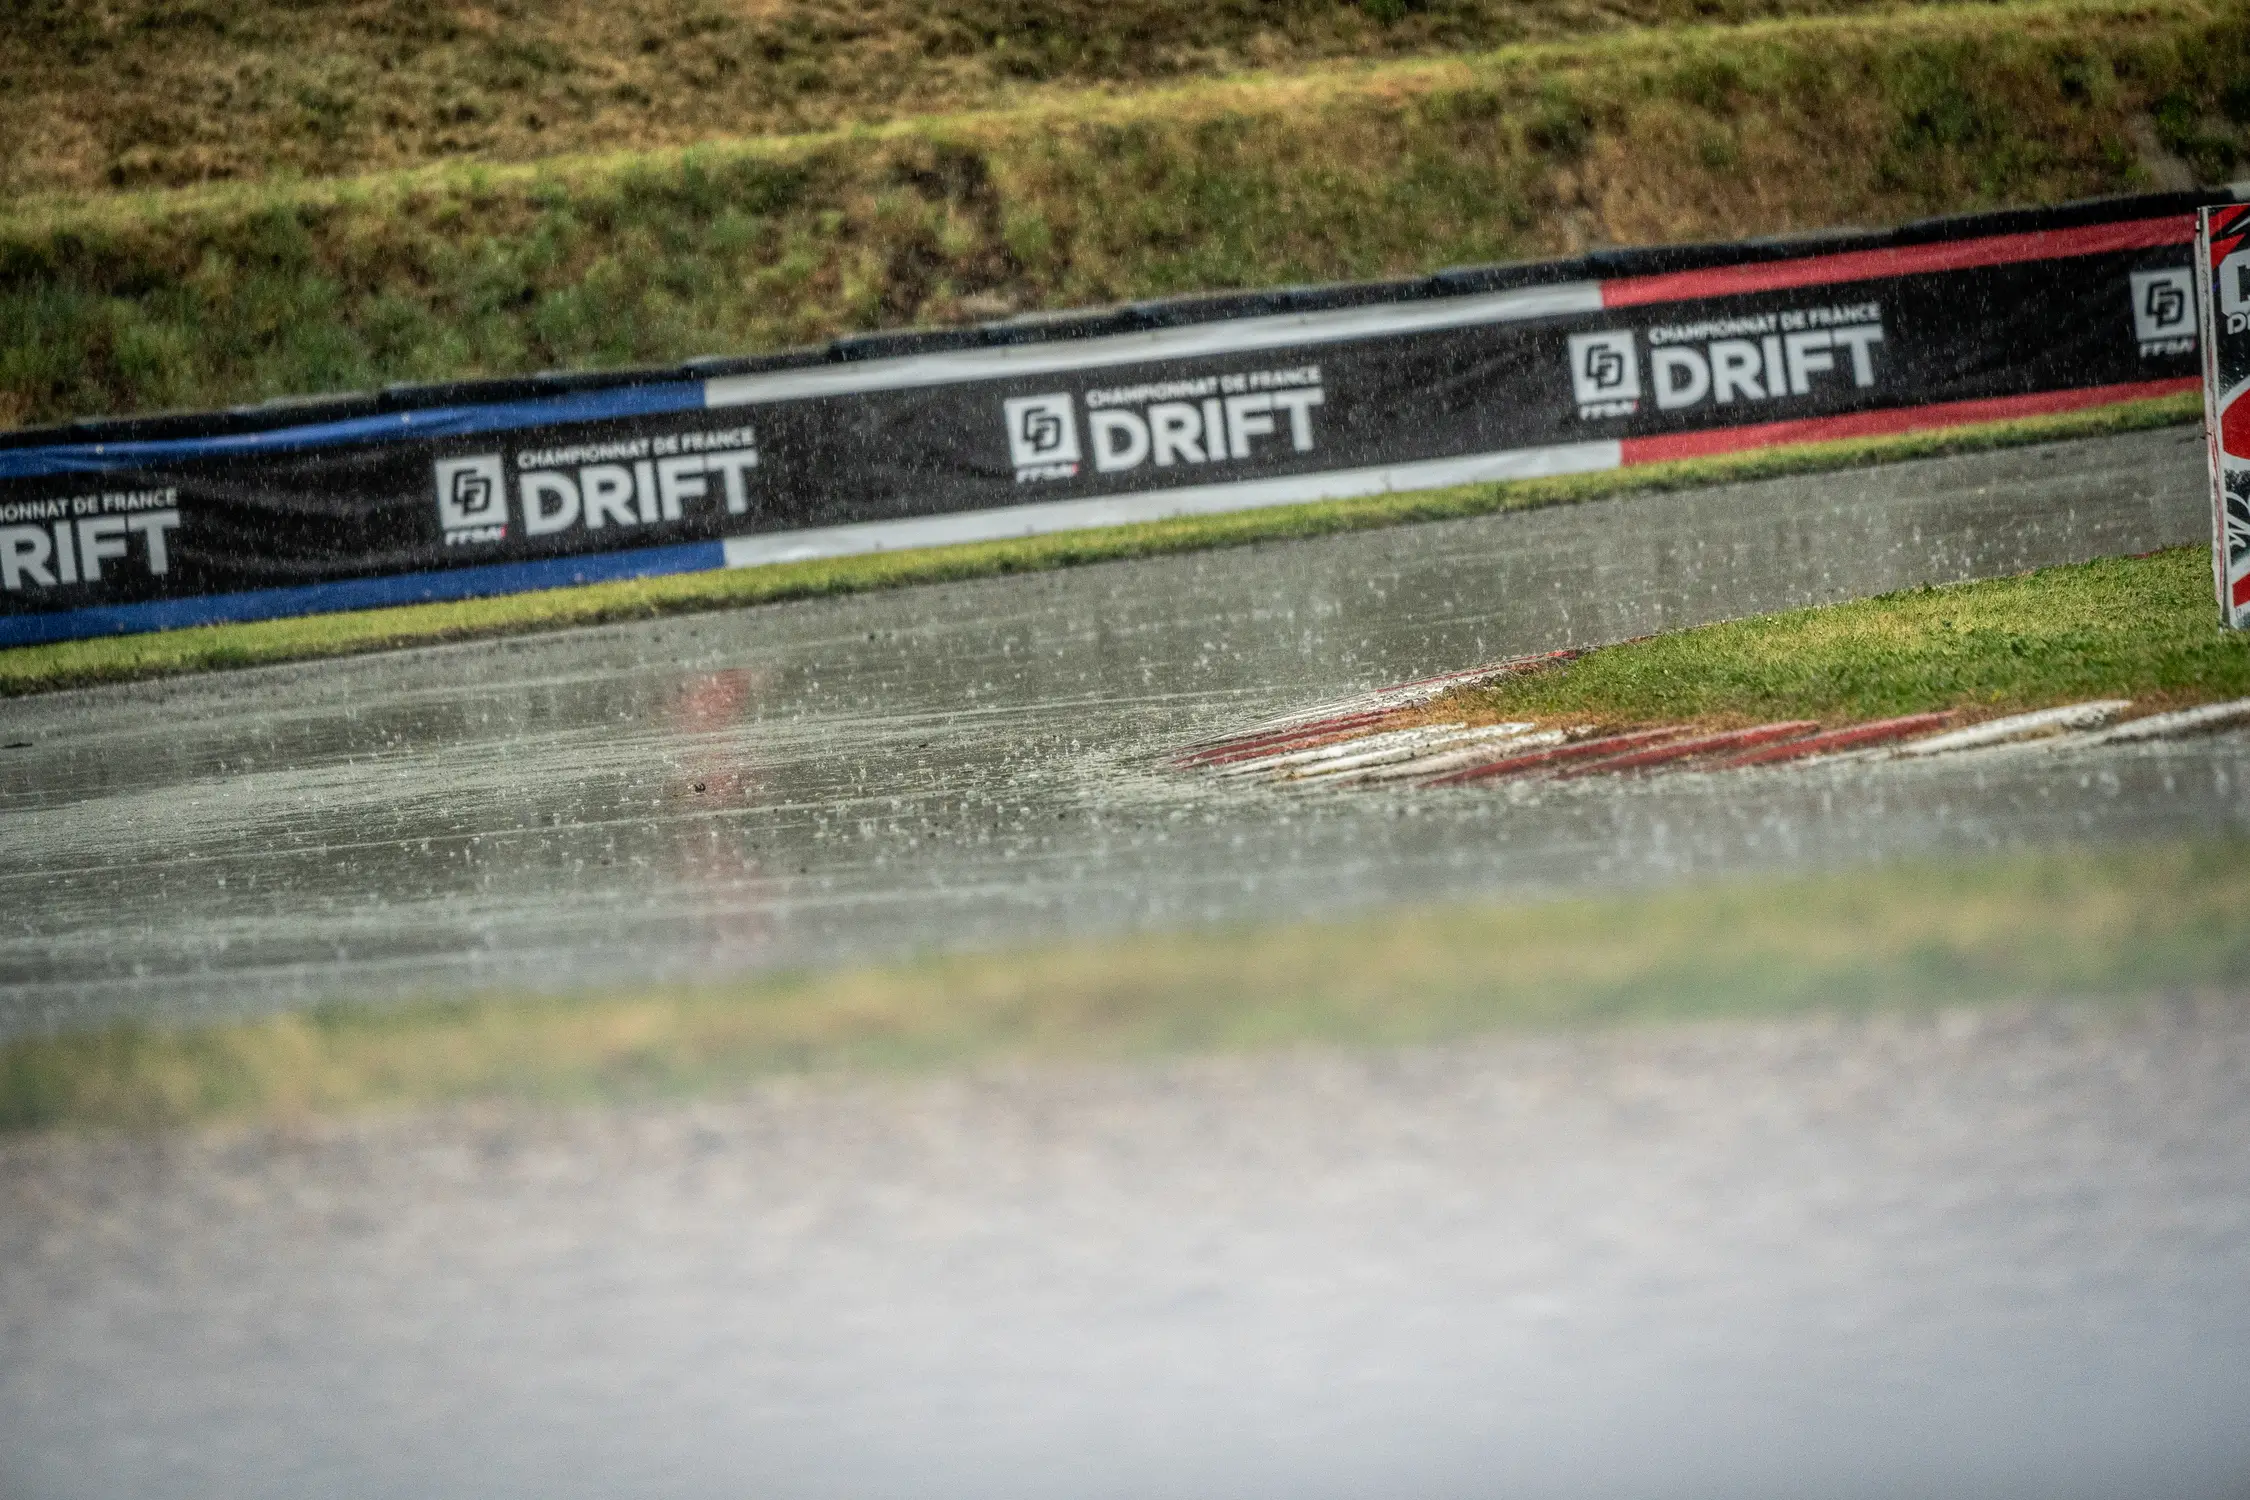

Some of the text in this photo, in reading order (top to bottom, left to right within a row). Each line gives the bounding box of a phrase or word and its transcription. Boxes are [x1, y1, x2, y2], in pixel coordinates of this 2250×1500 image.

[1648, 303, 1881, 345] CHAMPIONNAT DE FRANCE
[1085, 365, 1322, 408] CHAMPIONNAT DE FRANCE
[1651, 323, 1884, 410] DRIFT
[517, 425, 755, 469] CHAMPIONNAT DE FRANCE
[1089, 388, 1324, 473] DRIFT
[73, 495, 99, 515] DE
[103, 487, 178, 512] FRANCE
[519, 452, 758, 536] DRIFT
[0, 509, 181, 590] RIFT
